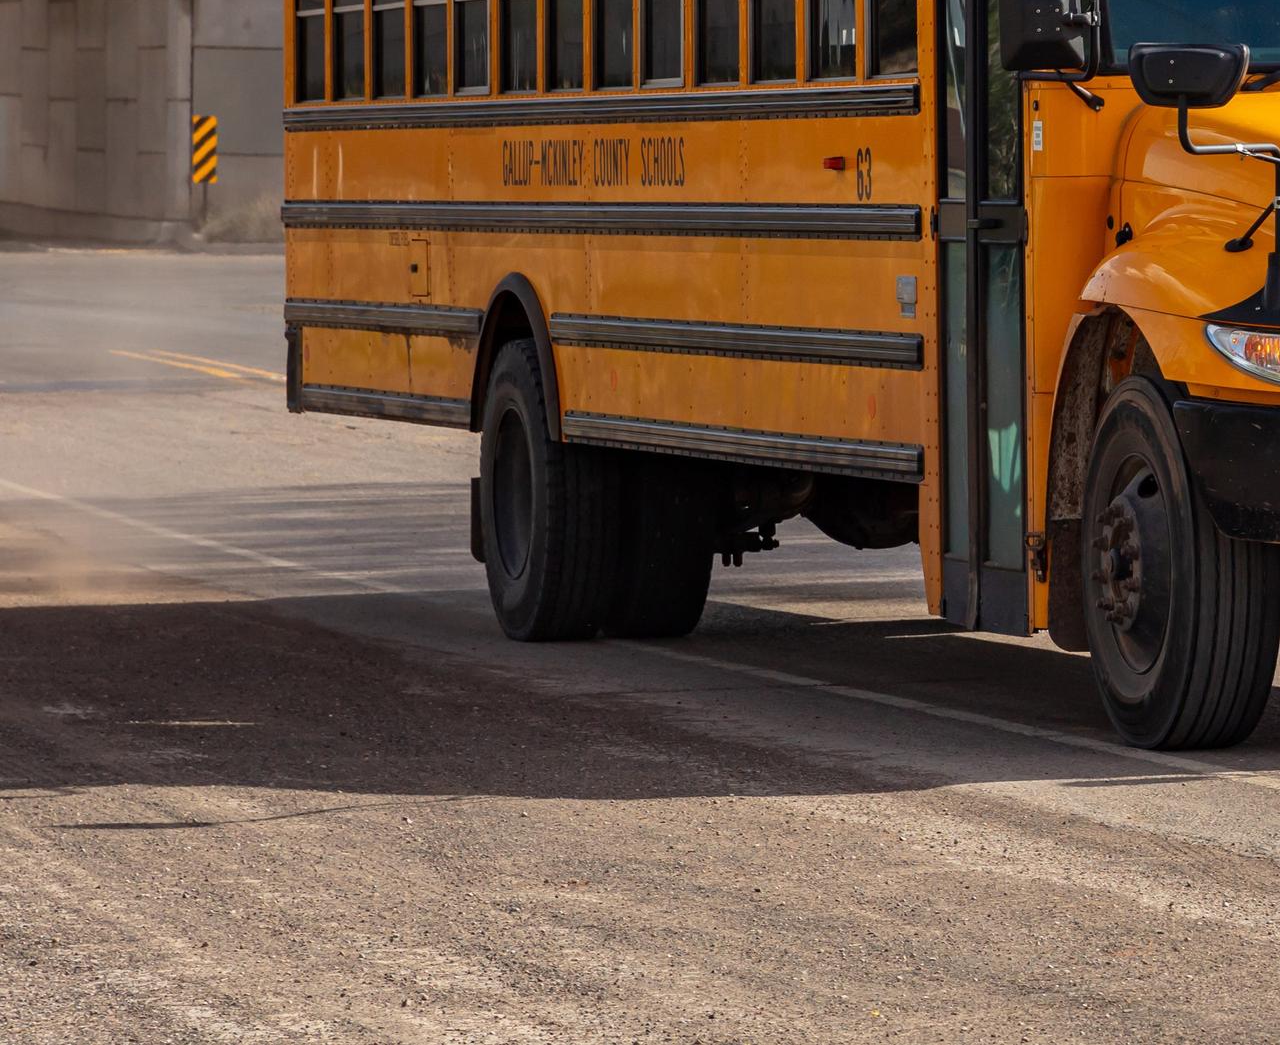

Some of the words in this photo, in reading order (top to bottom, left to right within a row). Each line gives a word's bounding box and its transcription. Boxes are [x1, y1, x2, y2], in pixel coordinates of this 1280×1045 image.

[503, 140, 584, 186] GALLUP-MCKINLEY
[594, 138, 630, 186] COUNTY
[641, 136, 685, 187] SCHOOLS
[856, 147, 872, 202] 63
